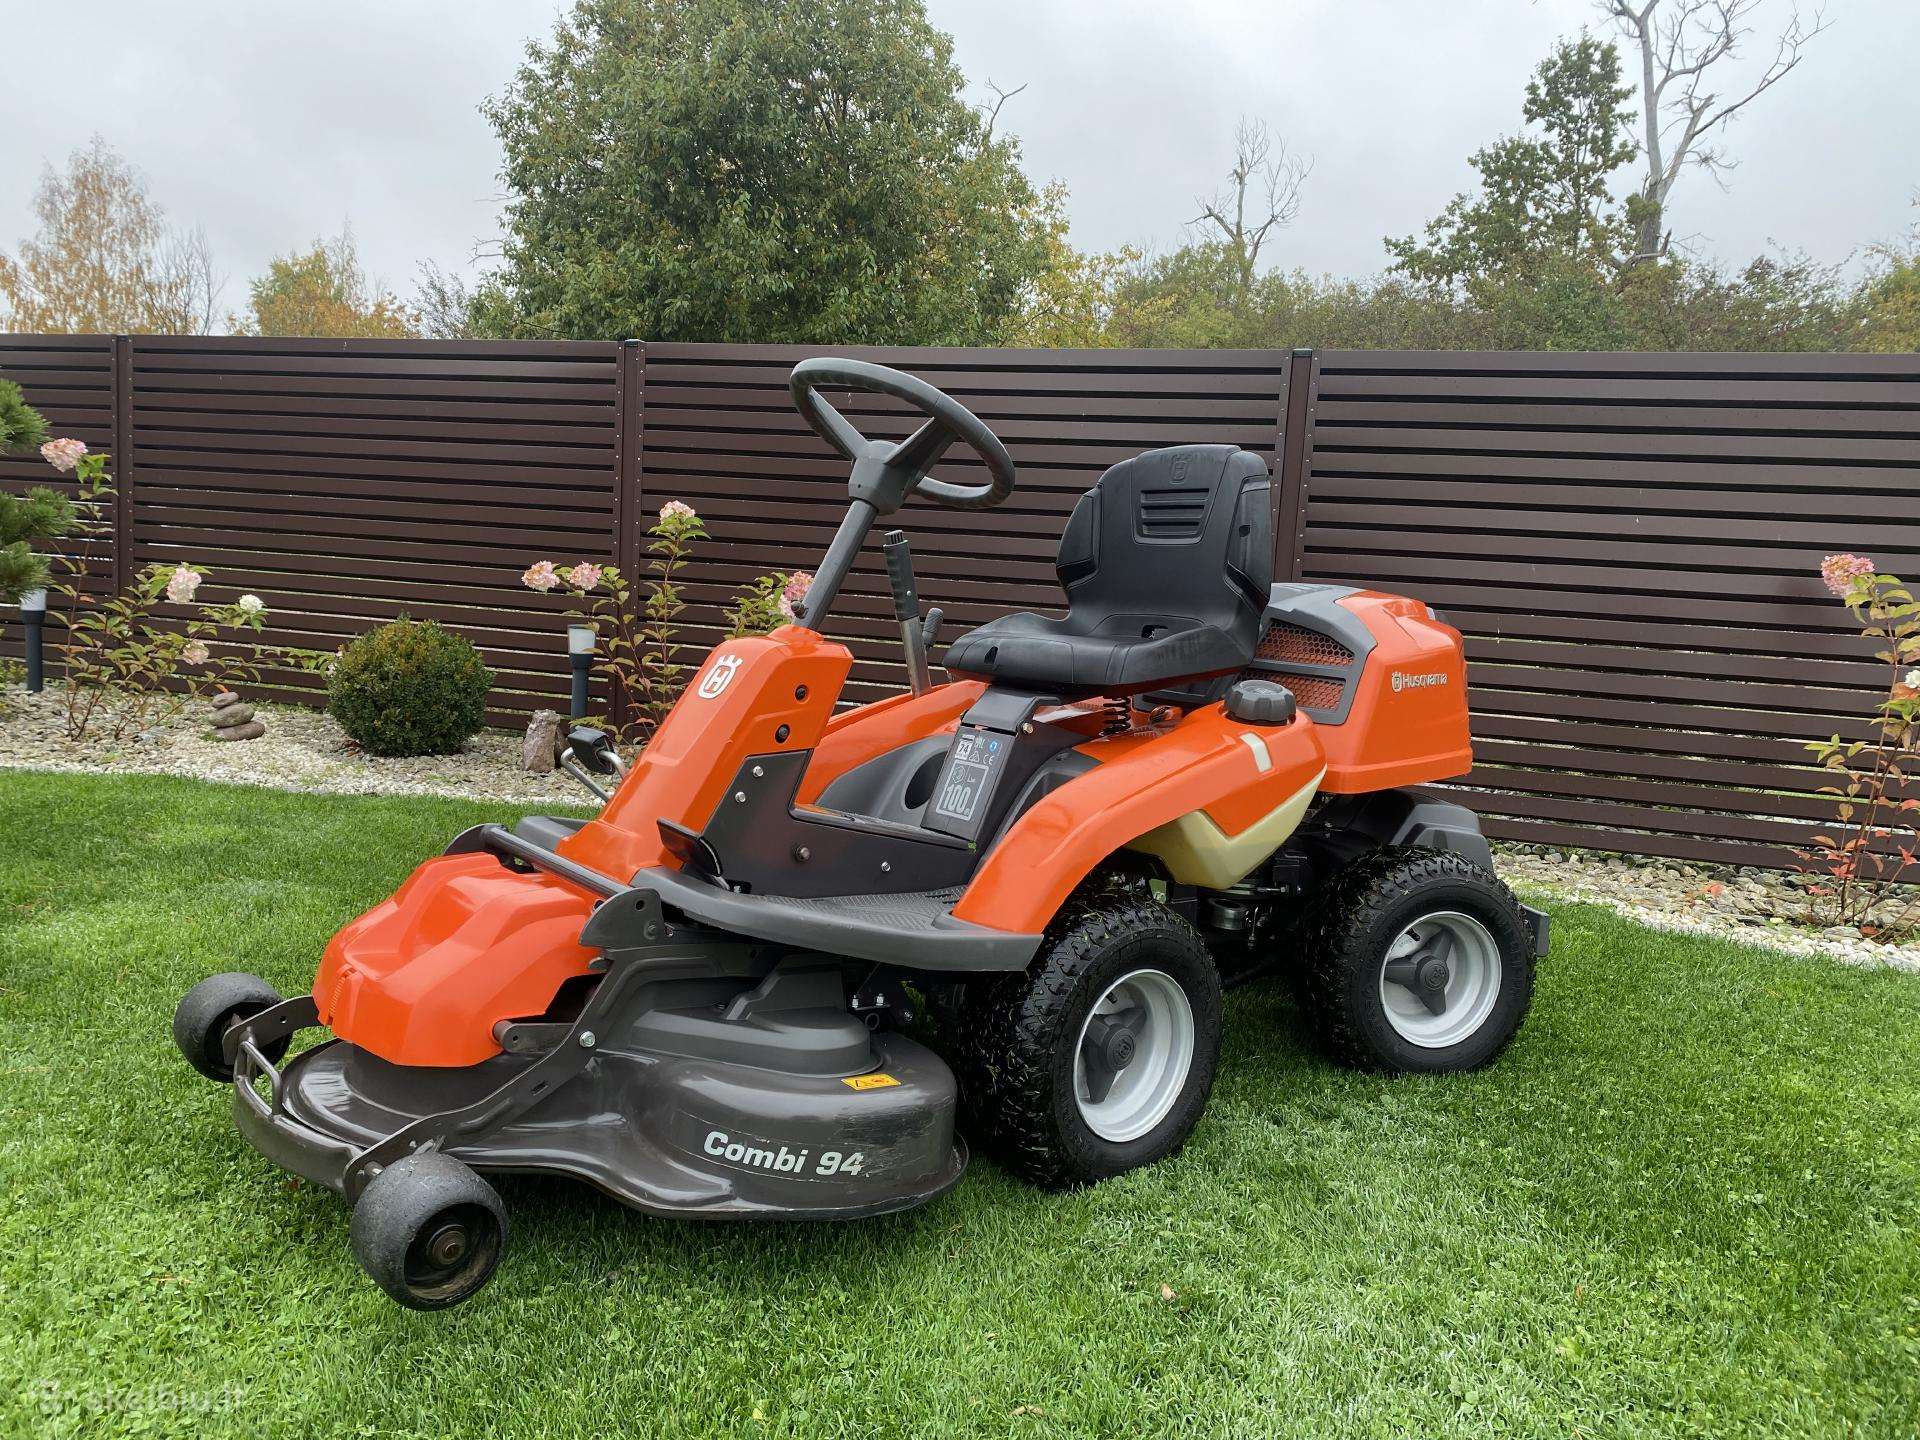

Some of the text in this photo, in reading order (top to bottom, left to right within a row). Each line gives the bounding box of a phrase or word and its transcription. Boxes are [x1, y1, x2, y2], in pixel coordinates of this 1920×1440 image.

[1402, 673, 1448, 688] Husqvarna
[943, 784, 971, 813] 100
[704, 1131, 865, 1176] Combi 94
